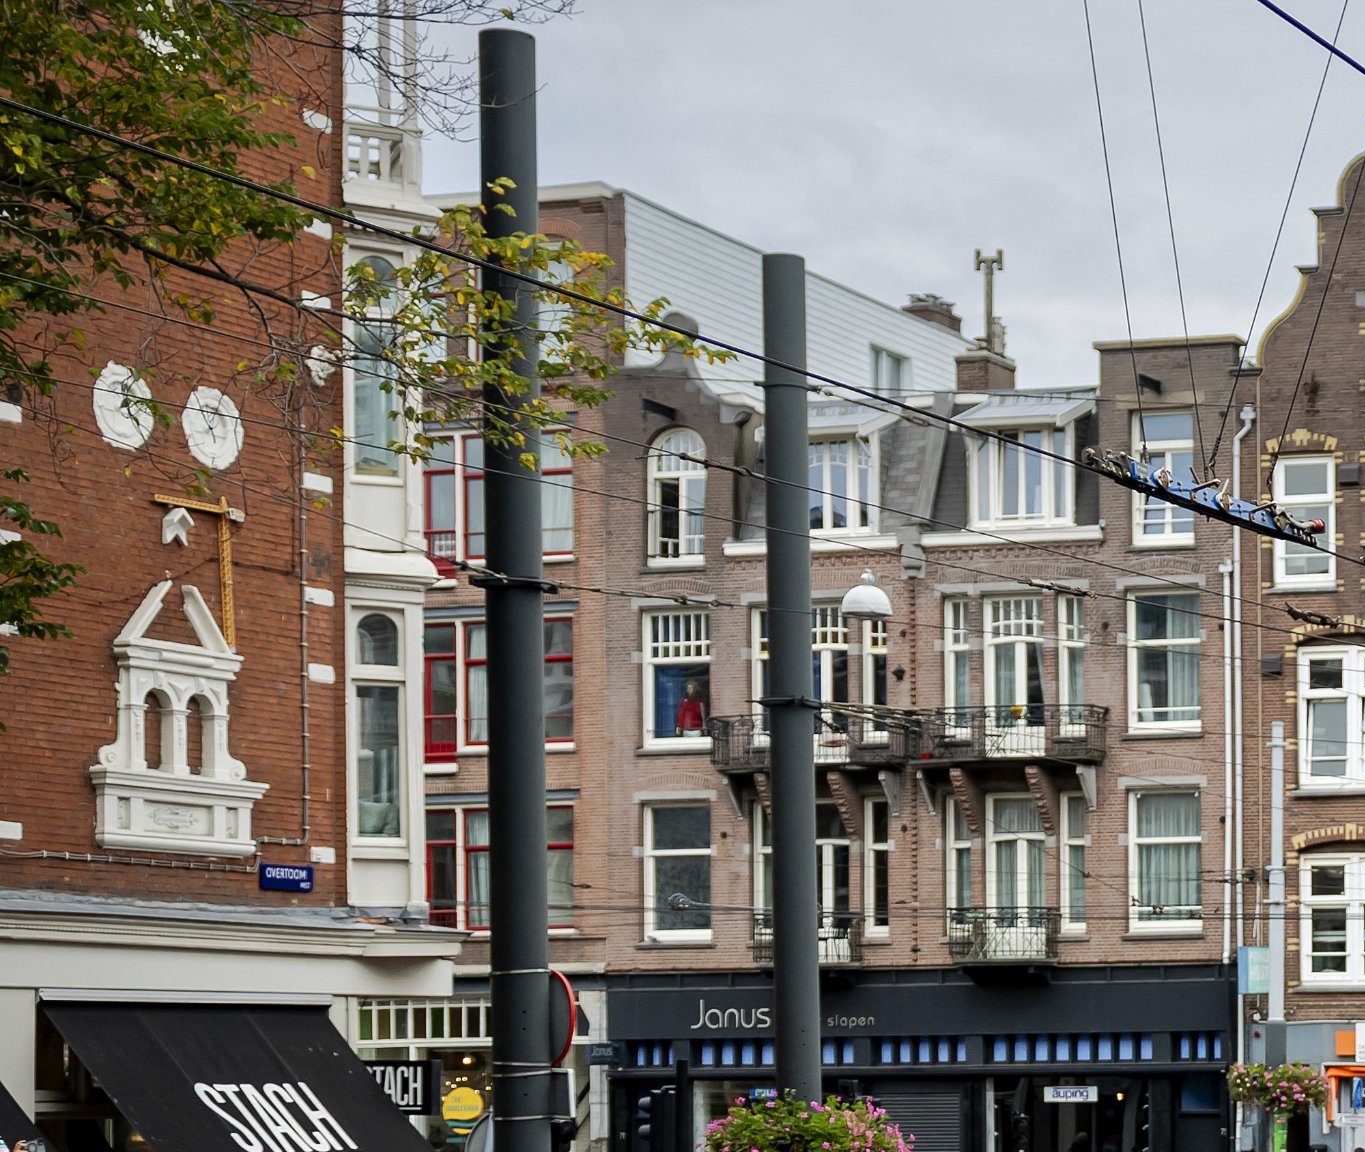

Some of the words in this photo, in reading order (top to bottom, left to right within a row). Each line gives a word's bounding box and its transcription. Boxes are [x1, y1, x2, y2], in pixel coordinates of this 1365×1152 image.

[266, 867, 307, 879] OVERTOOM
[690, 999, 772, 1029] Janus
[828, 1015, 875, 1030] slapen
[1052, 1086, 1089, 1100] auping
[194, 1082, 358, 1152] STACH
